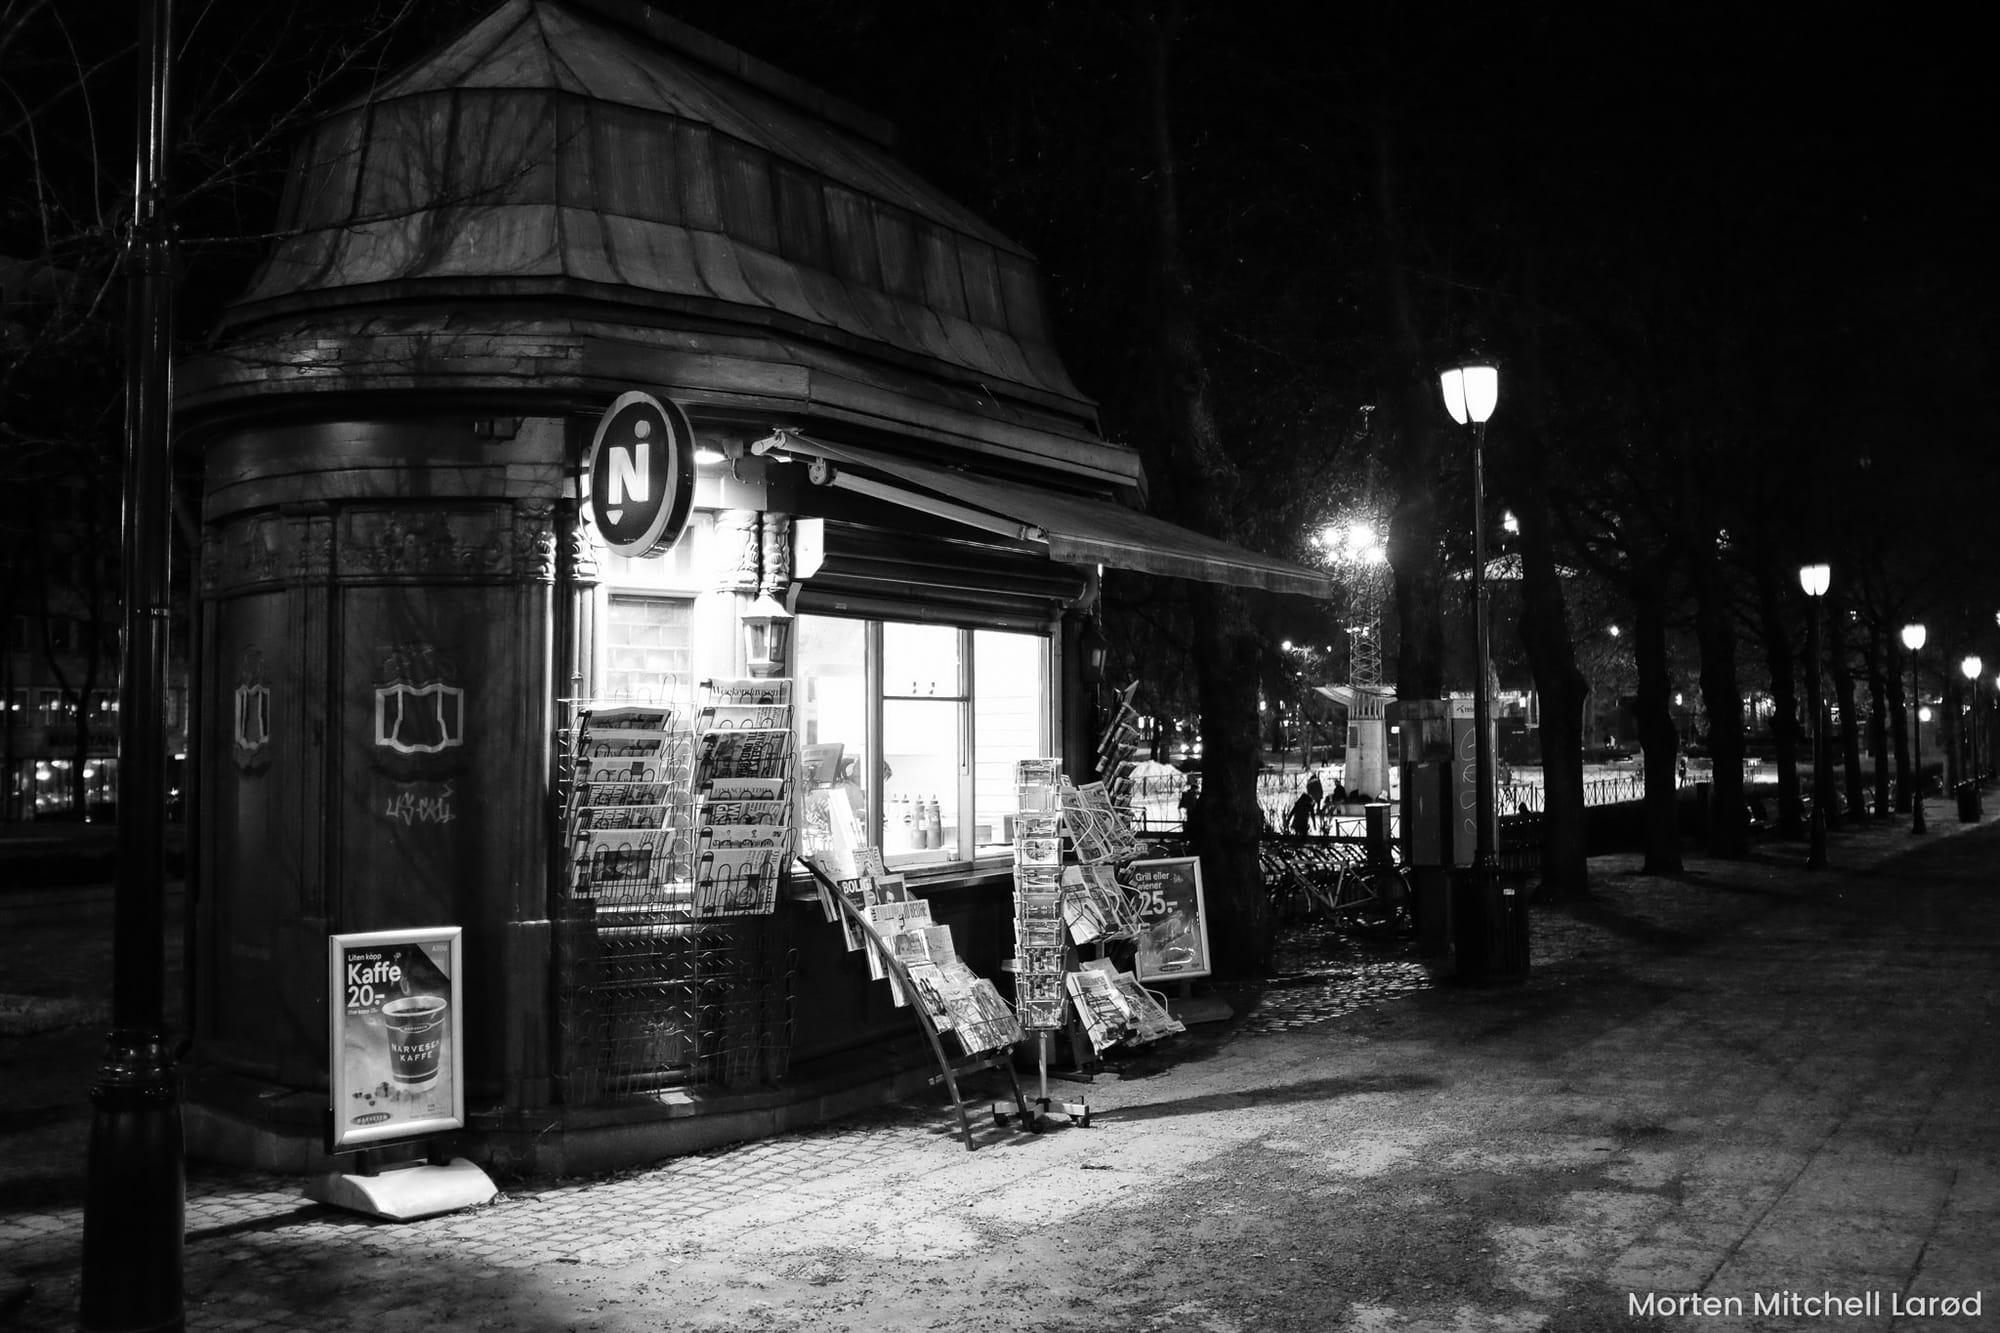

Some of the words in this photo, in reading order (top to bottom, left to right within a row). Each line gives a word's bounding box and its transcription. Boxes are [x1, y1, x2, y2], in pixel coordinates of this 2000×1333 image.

[1135, 873, 1151, 882] Grill
[1153, 872, 1169, 881] eller
[348, 954, 365, 962] Liten
[347, 961, 402, 985] Kaffe
[399, 1051, 433, 1062] KAFFE
